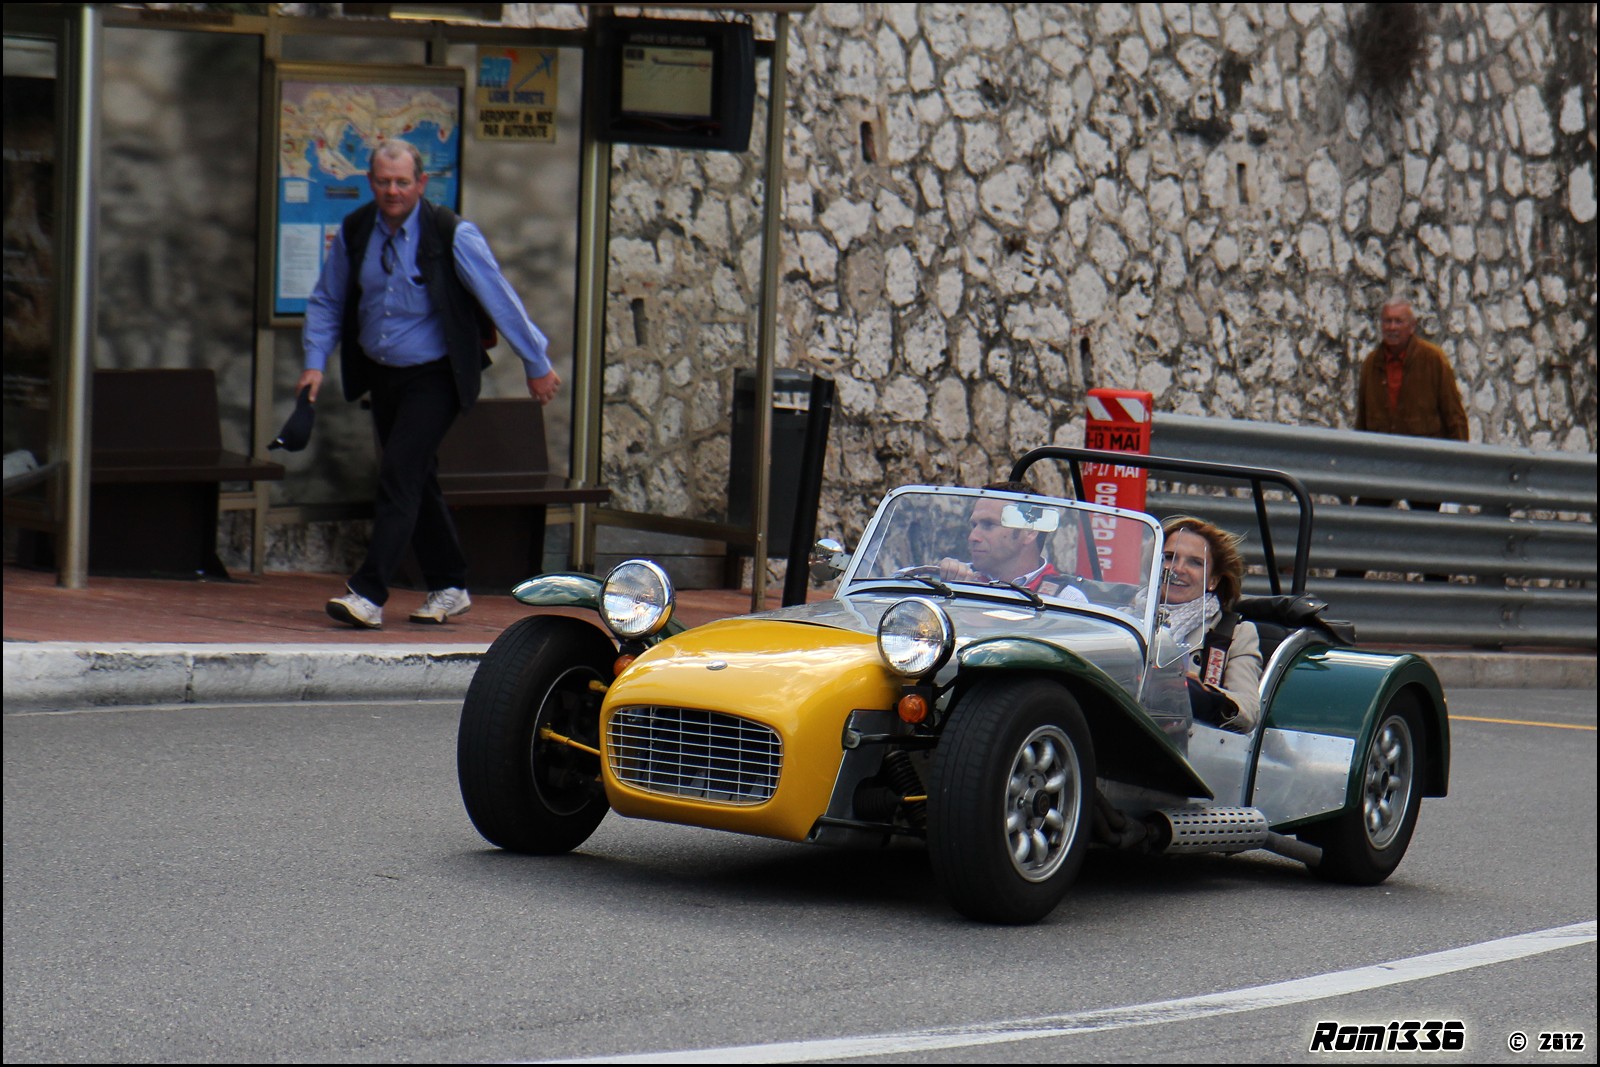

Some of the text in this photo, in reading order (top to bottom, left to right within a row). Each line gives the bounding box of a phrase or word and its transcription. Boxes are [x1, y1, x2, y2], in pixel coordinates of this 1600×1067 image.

[503, 124, 547, 138] AUTOROUTE
[1110, 433, 1140, 451] MAI
[1114, 464, 1140, 479] MAI
